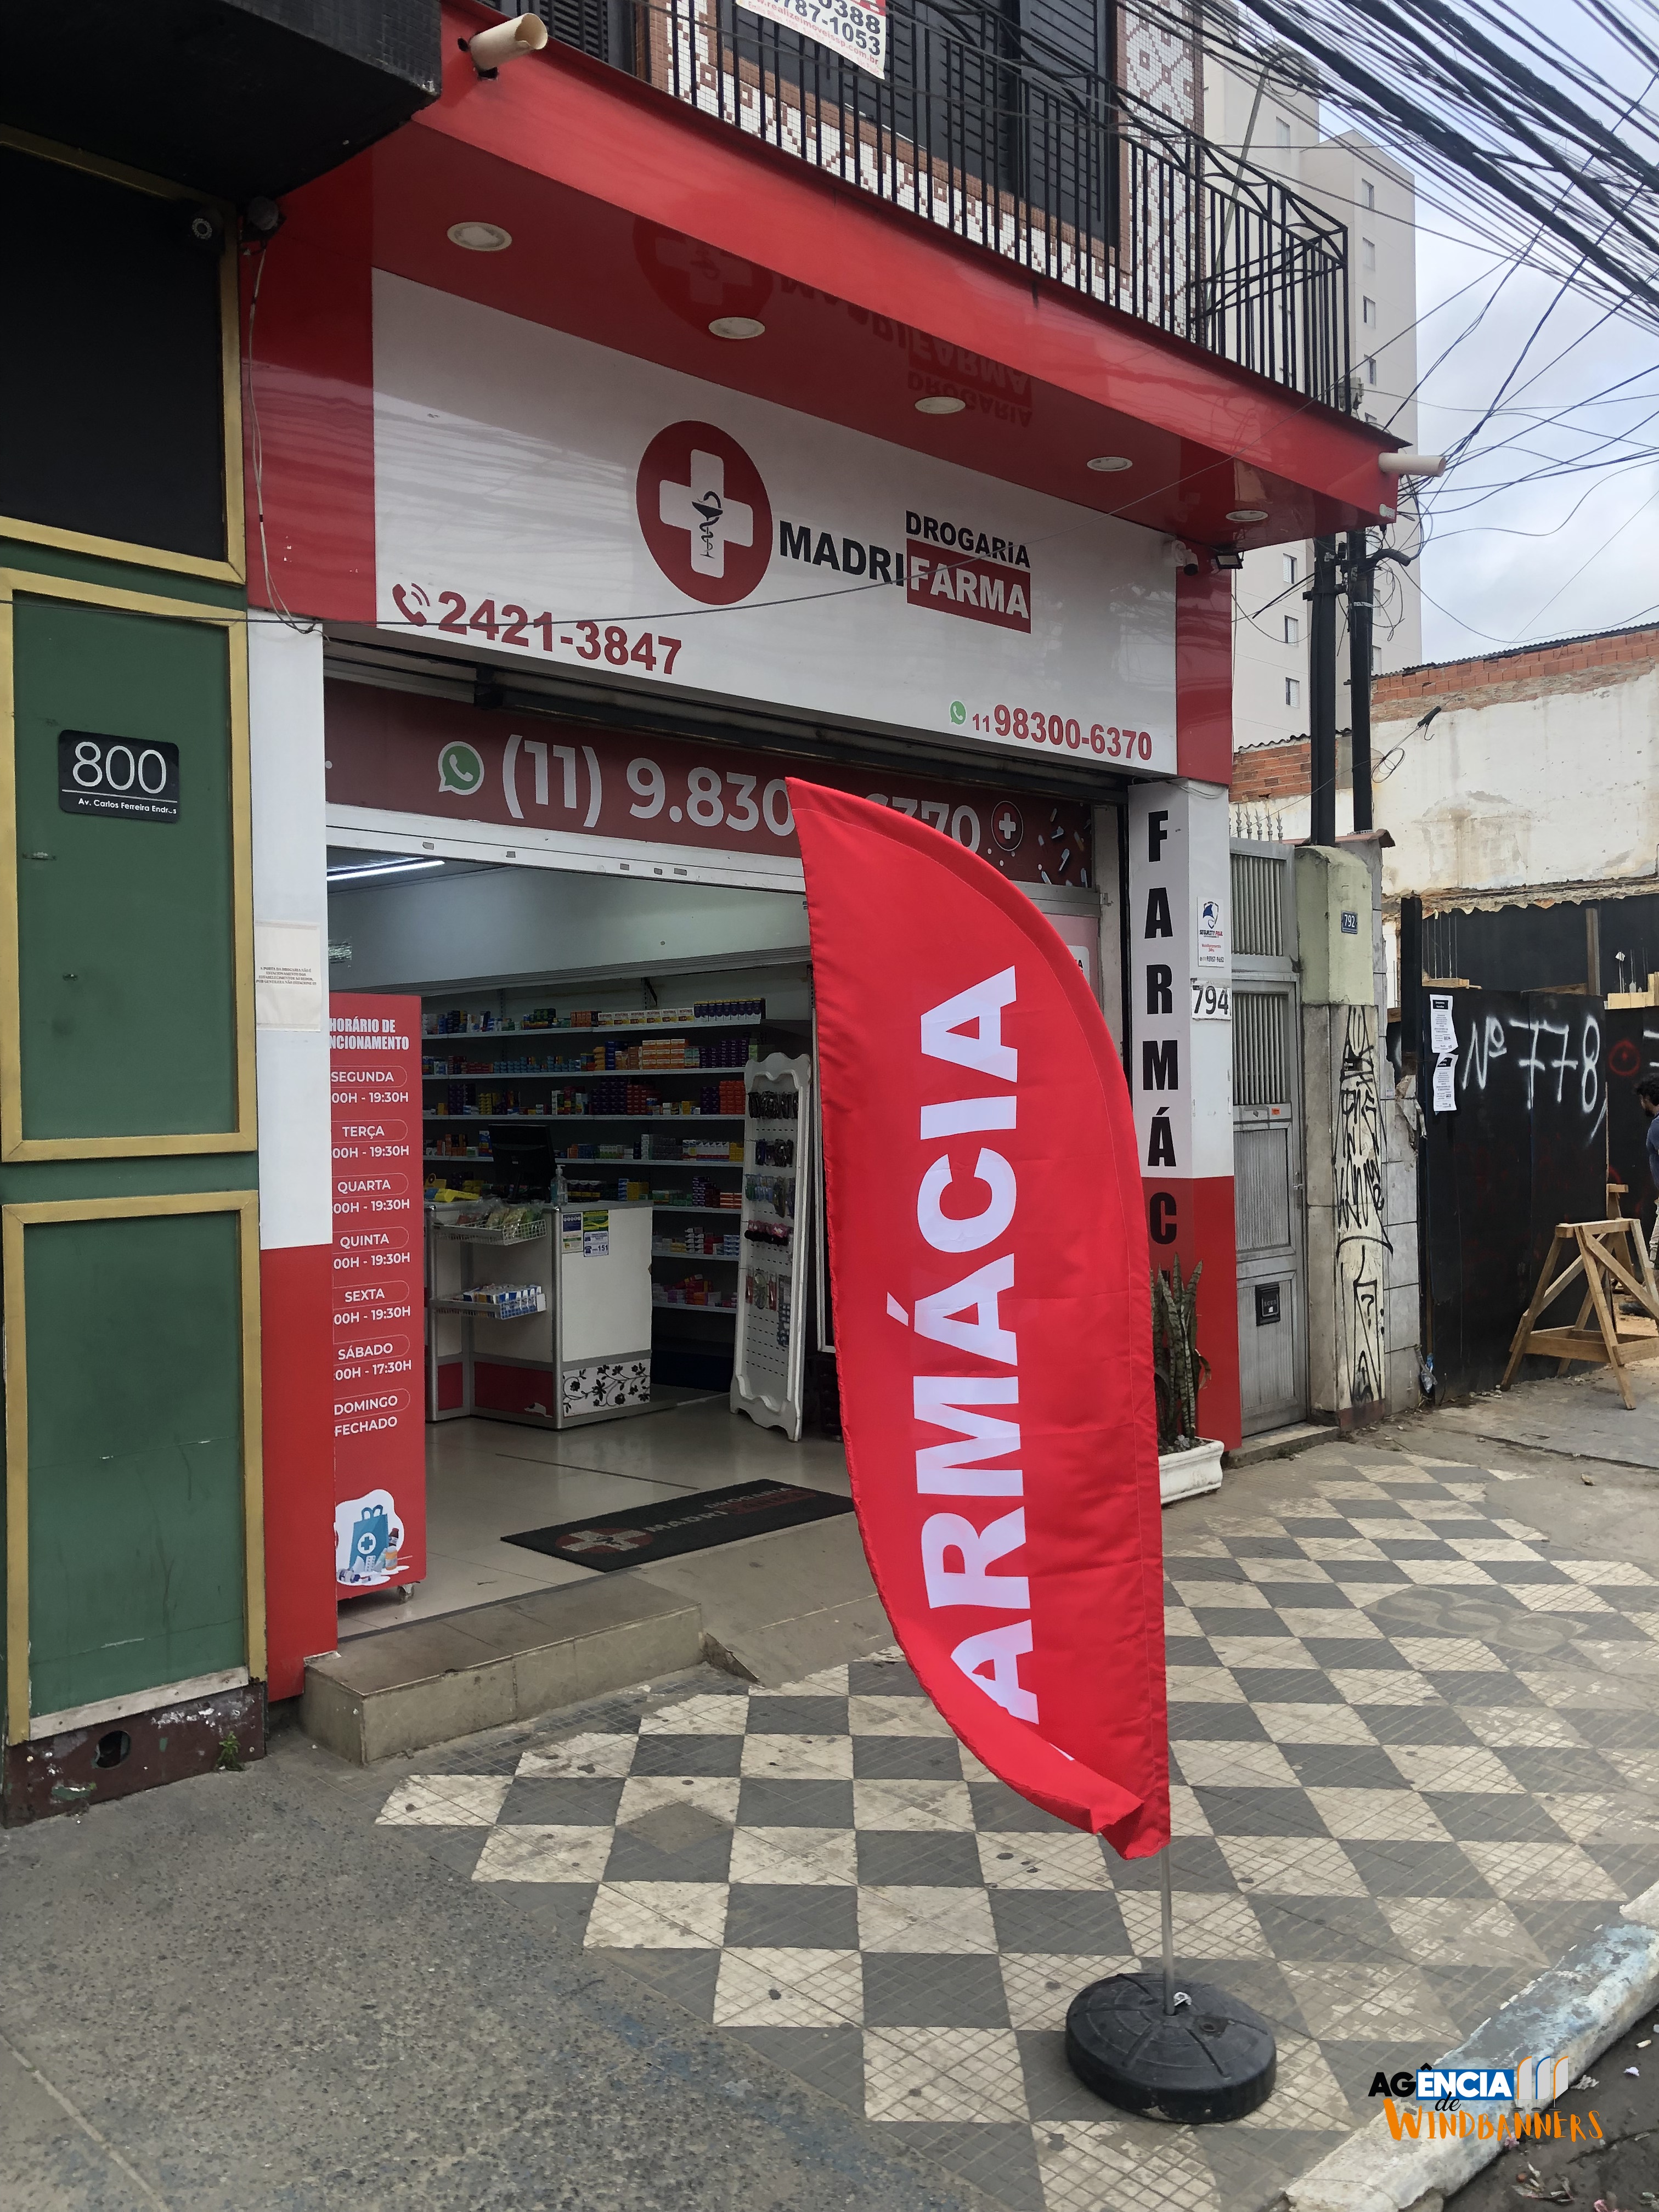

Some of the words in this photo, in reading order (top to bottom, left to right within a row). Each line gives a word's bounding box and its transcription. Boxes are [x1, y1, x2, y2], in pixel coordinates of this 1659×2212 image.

[905, 510, 1031, 568] DROGARIA
[438, 591, 682, 675] 2421-3847
[972, 713, 990, 733] 11
[994, 704, 1152, 760] 98300-6370
[72, 741, 167, 794] 800
[502, 734, 602, 828] (11)
[78, 798, 92, 806] Av.
[93, 799, 119, 809] Carlos
[120, 802, 150, 811] Ferreira
[1344, 914, 1355, 928] 792
[1192, 985, 1229, 1015] 794
[329, 1016, 380, 1033] HORÁRIO
[382, 1019, 396, 1033] DE
[1142, 810, 1179, 1245] FARMÁC
[329, 1035, 409, 1050] NCIONAMENTO
[331, 1071, 394, 1082] SEGUNDA
[331, 1092, 357, 1103] 00H
[369, 1092, 409, 1103] 19:30H
[342, 1126, 385, 1139] TERÇA
[331, 1147, 358, 1159] 00H
[369, 1146, 409, 1158] 19:30H
[337, 1179, 391, 1194] QUARTA
[332, 1203, 359, 1214] 00H
[370, 1198, 410, 1211] 19:30H
[340, 1233, 390, 1250] QUINTA
[333, 1257, 359, 1269] 00H
[370, 1252, 410, 1266] 19:30H
[345, 1288, 385, 1303] SEXTA
[334, 1311, 360, 1325] 00H
[371, 1306, 411, 1321] 19:30H
[338, 1342, 393, 1361] SÁBADO
[887, 964, 1040, 1725] ARMÁCIA
[372, 1359, 412, 1376] 17:30H
[334, 1395, 398, 1415] DOMINGO
[335, 1416, 398, 1437] FECHADO
